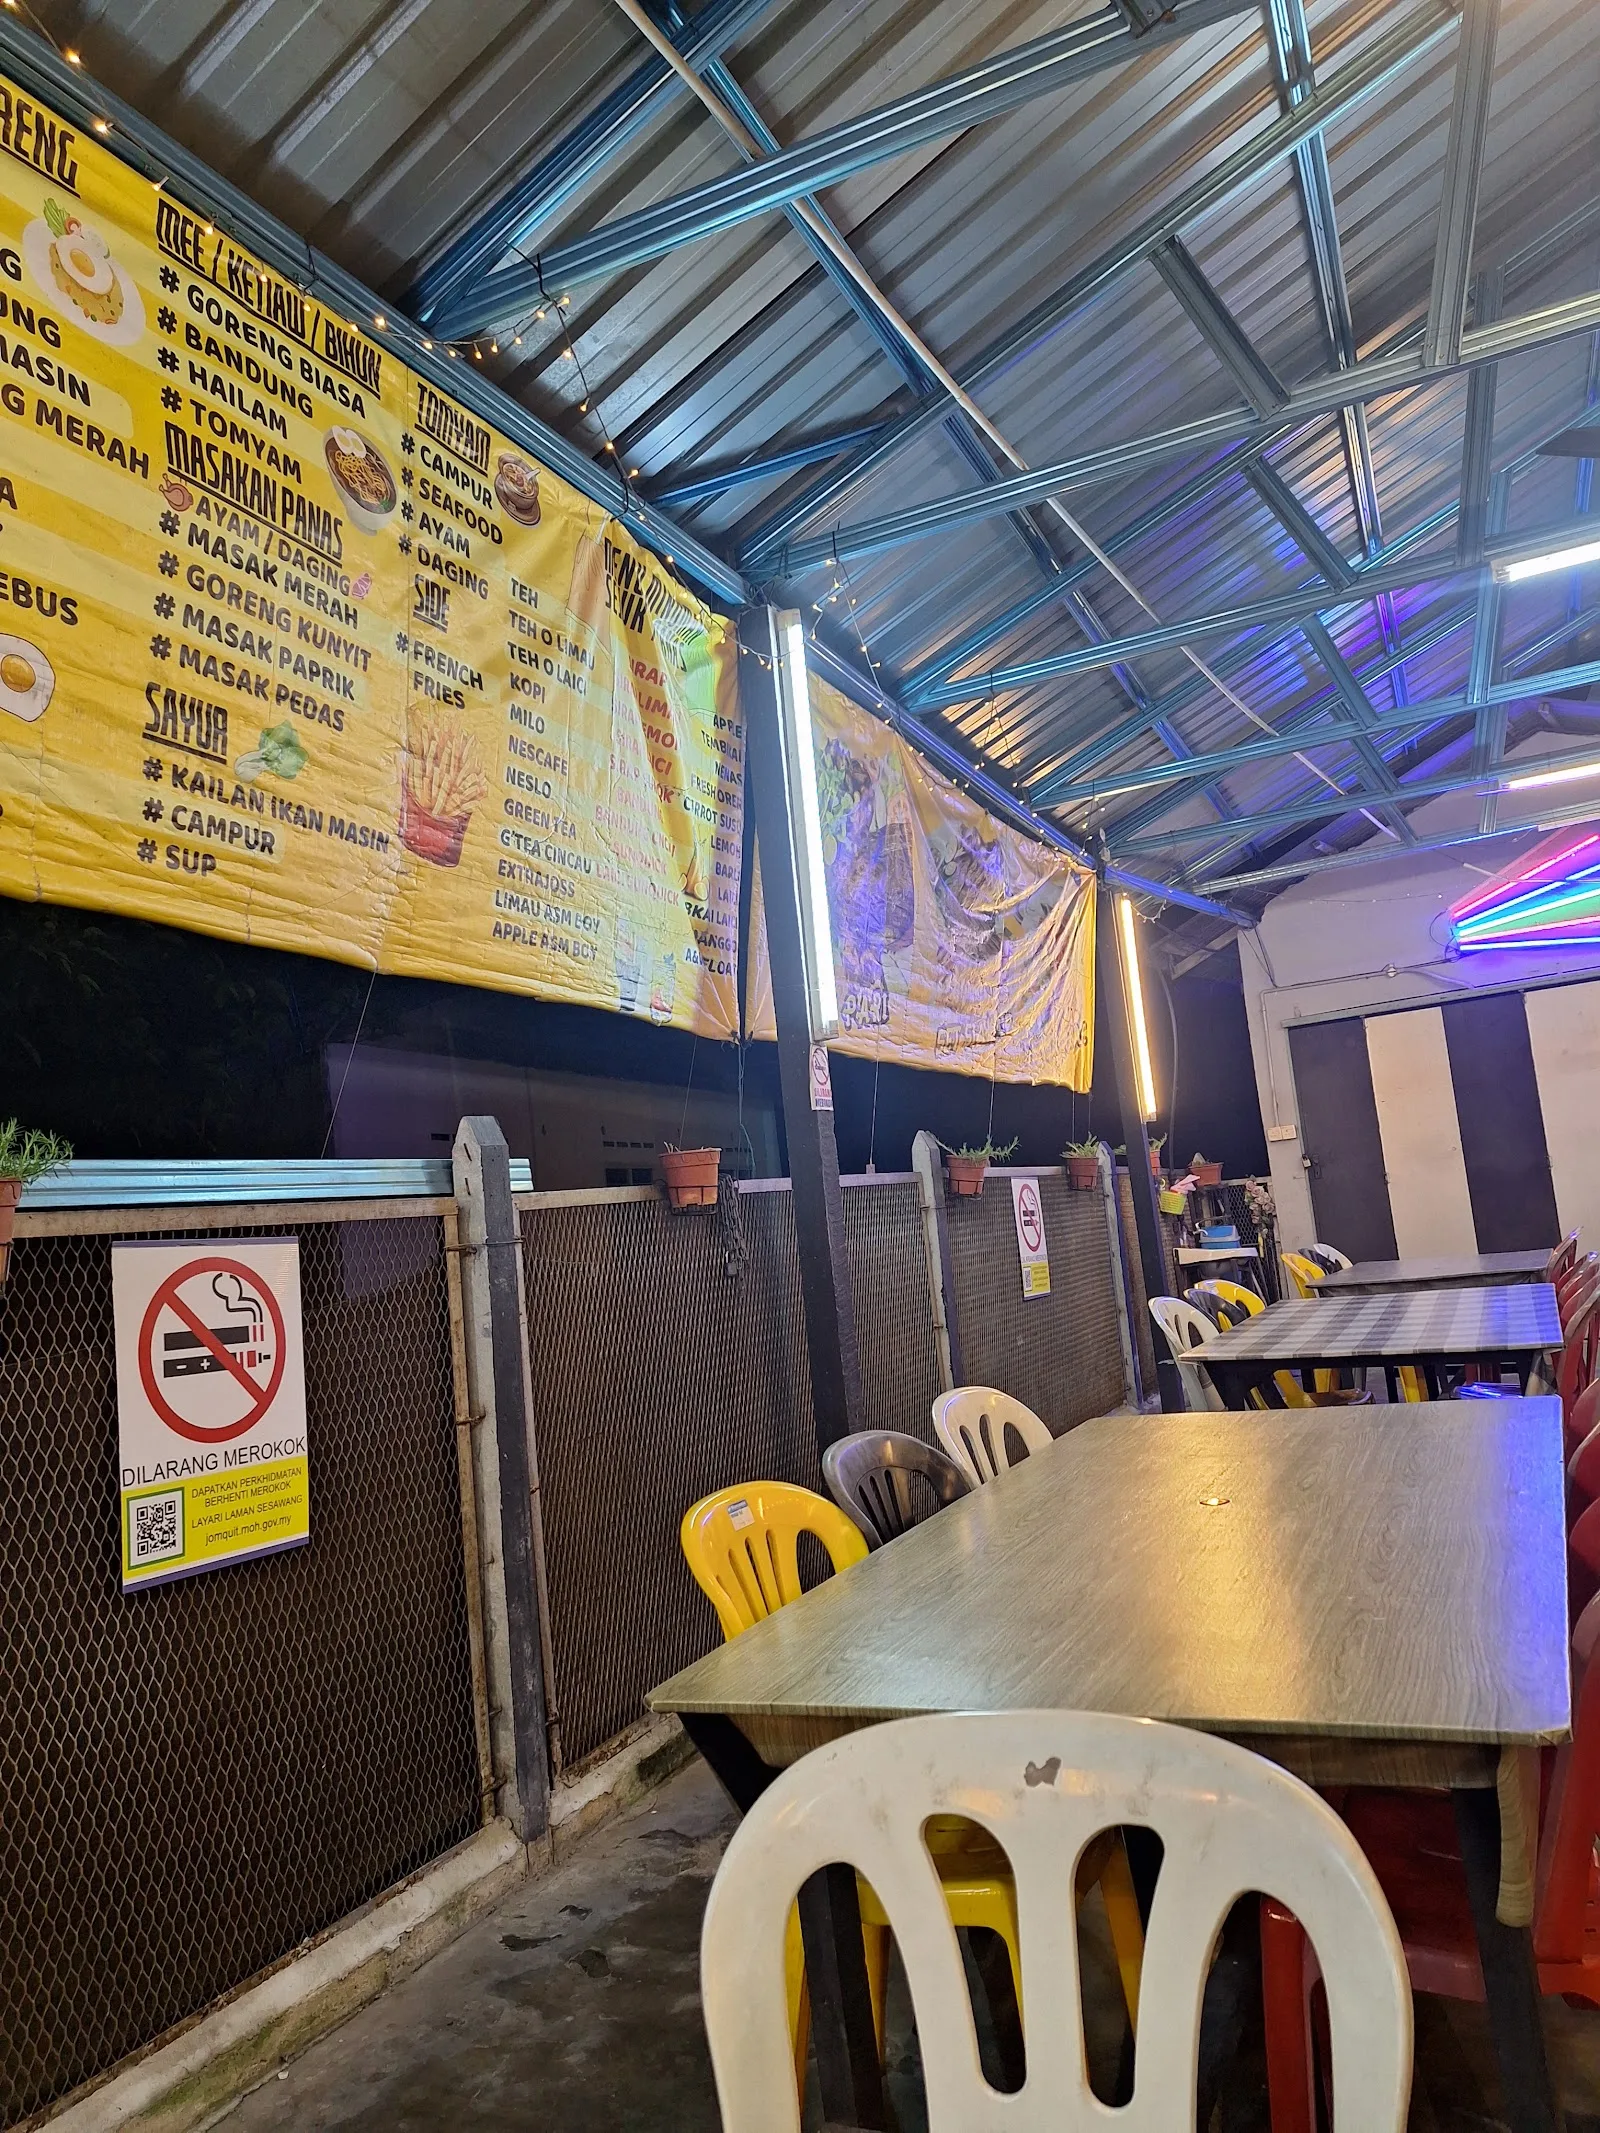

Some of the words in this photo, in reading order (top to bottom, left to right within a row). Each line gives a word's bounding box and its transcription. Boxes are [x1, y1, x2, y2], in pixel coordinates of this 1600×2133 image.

[0, 290, 61, 348] NG
[156, 197, 206, 273] MEE
[324, 318, 382, 393] BIHUN
[185, 322, 313, 419] BANDUNG
[187, 284, 293, 370] GORENG
[300, 357, 366, 419] BIASA
[188, 360, 288, 440] HAILAM
[417, 381, 491, 471] TOMYAM
[35, 399, 149, 479] MERAH
[189, 398, 302, 485] TOMYAM
[164, 420, 277, 523] MASAKAN
[282, 485, 343, 561] PANAS
[420, 445, 493, 510] CAMPUR
[418, 477, 503, 545] SEAFOOD
[419, 511, 471, 559] AYAM
[196, 495, 260, 546] AYAM
[278, 538, 351, 596] DAGING
[417, 543, 489, 600] DAGING
[187, 522, 278, 587] MASAK
[284, 570, 358, 629] MERAH
[414, 573, 450, 627] SIDE
[510, 577, 539, 609] TEH
[186, 564, 292, 633] GORENG
[297, 615, 371, 672] KUNYIT
[509, 609, 538, 640] TEH
[541, 628, 553, 646] O
[557, 635, 595, 671] LIMAU
[182, 603, 273, 664] MASAK
[278, 645, 355, 701] PAPRIK
[413, 640, 484, 691] FRENCH
[507, 641, 539, 670] TEH
[543, 658, 554, 676] O
[179, 644, 270, 701] MASAK
[275, 683, 345, 731] PEDAS
[412, 670, 466, 710] FRIES
[510, 672, 545, 704] KOPI
[145, 681, 228, 755] SAYUR
[510, 703, 545, 734] MILO
[508, 734, 568, 776] NESCAFE
[171, 763, 265, 814] KAILAN
[271, 795, 324, 833] IKAN
[328, 815, 389, 853] MASIN
[506, 765, 552, 799] NESLO
[171, 805, 275, 855] CAMPUR
[503, 797, 550, 830] GREEN
[553, 816, 577, 840] TEA
[165, 844, 217, 876] SUP
[498, 858, 575, 898] EXTRAJOSS
[545, 843, 592, 875] CINCAU
[495, 889, 540, 917] LIMAU
[492, 920, 537, 947] APPLE
[122, 1453, 218, 1487] DILARANG
[224, 1436, 306, 1468] MEROKOK
[192, 1480, 238, 1498] DAPATKAN
[240, 1467, 302, 1487] PERKHIDMATAN
[192, 1512, 222, 1528] LAYARI
[225, 1506, 254, 1521] LAMAN
[257, 1495, 302, 1512] SESAWANG
[205, 1492, 249, 1507] BERHENTI
[250, 1480, 291, 1497] MEROKOK
[205, 1516, 292, 1546] jomquit.moh.gov.my
